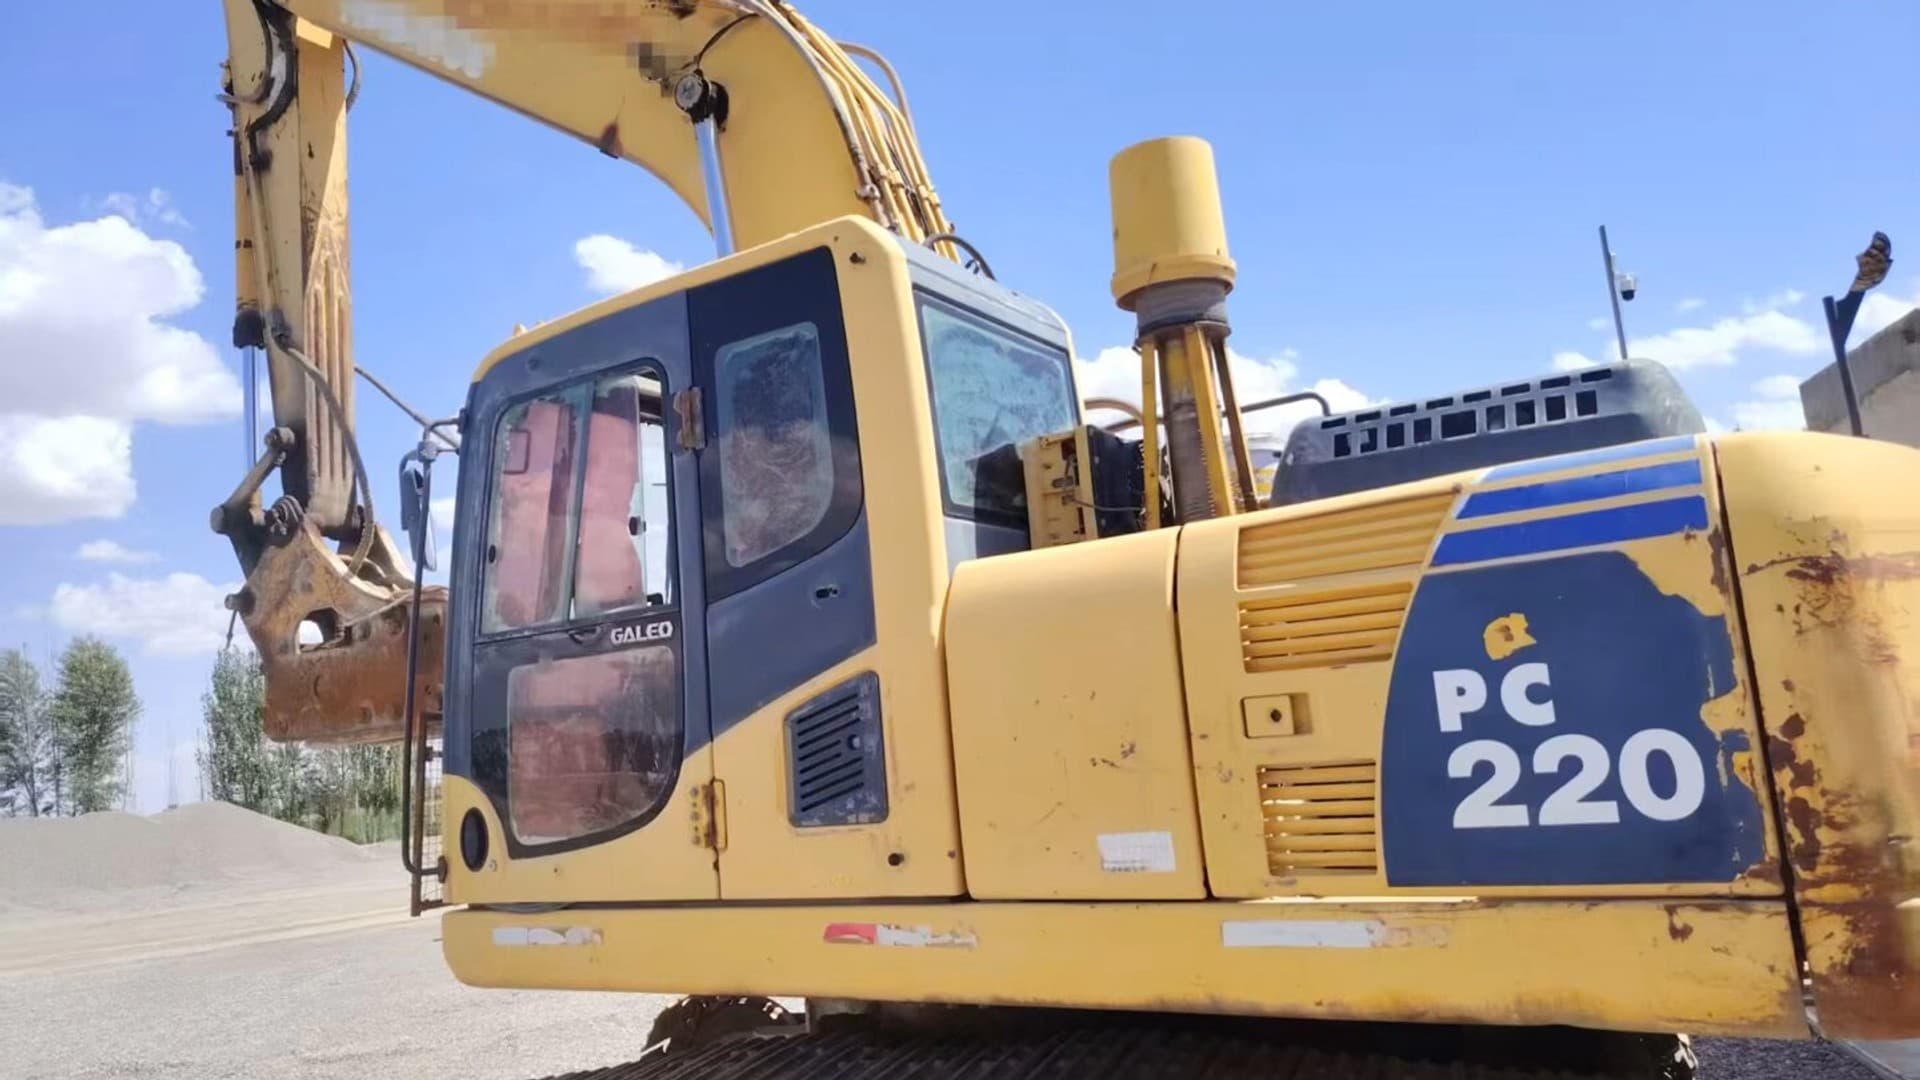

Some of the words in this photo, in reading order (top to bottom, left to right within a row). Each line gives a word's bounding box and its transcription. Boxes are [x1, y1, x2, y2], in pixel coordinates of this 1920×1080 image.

[610, 620, 673, 645] GALEO
[1433, 662, 1556, 732] PC
[1447, 728, 1705, 828] 220
